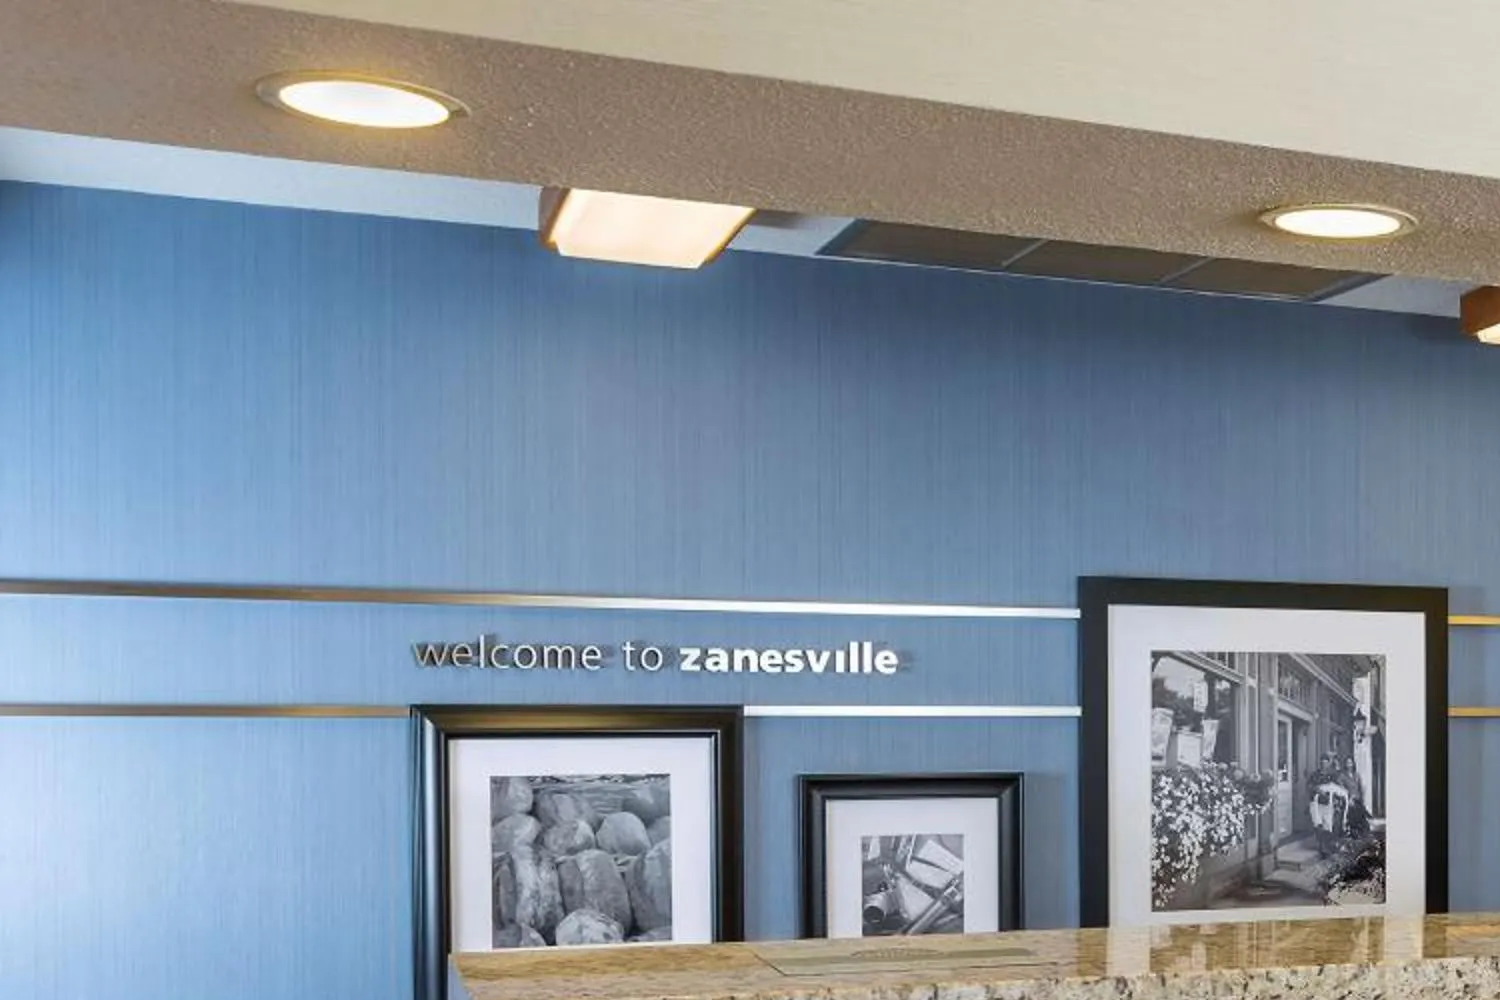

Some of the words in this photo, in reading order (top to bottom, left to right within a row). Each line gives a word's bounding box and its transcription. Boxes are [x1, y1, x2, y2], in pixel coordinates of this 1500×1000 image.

[413, 634, 601, 671] welcome
[622, 640, 663, 672] to
[679, 641, 899, 675] zanesville
